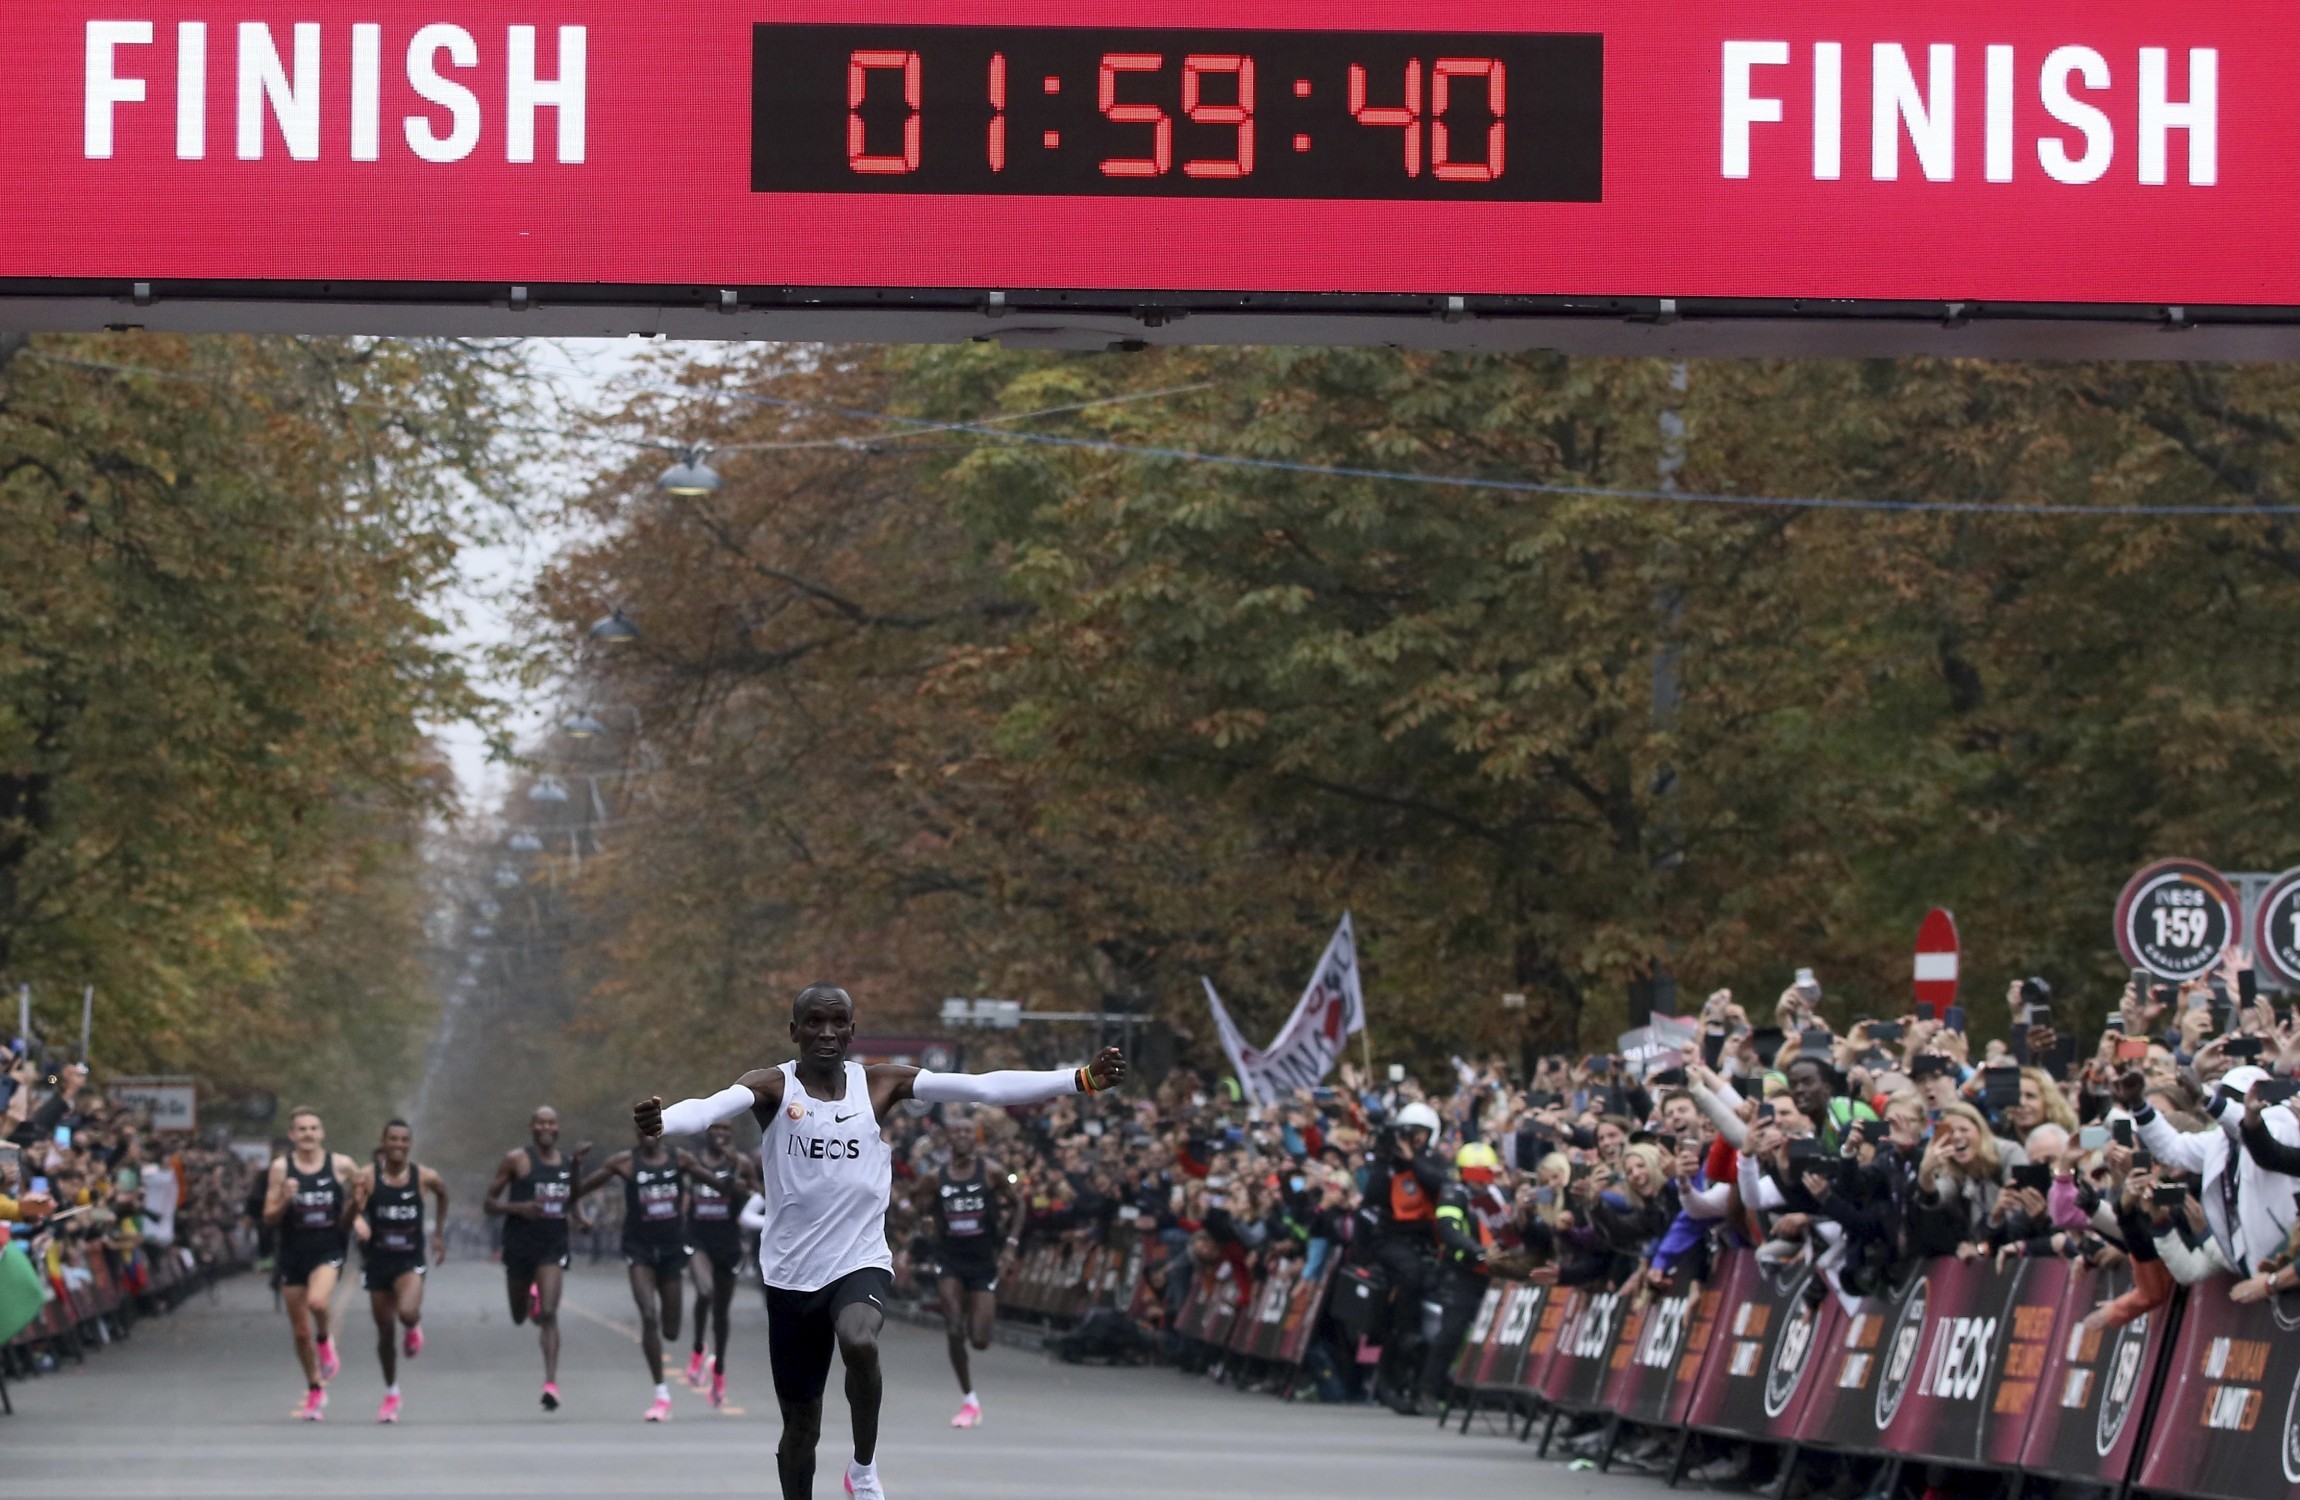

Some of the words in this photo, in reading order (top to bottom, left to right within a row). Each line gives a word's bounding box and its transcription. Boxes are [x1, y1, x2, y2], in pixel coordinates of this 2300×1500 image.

[84, 21, 587, 163] FINISH
[847, 49, 1506, 181] 01:59:40
[1721, 41, 2218, 187] FINISH
[2151, 906, 2208, 948] 1:59
[787, 1133, 860, 1160] INEOS
[1917, 1316, 1997, 1401] INEOS
